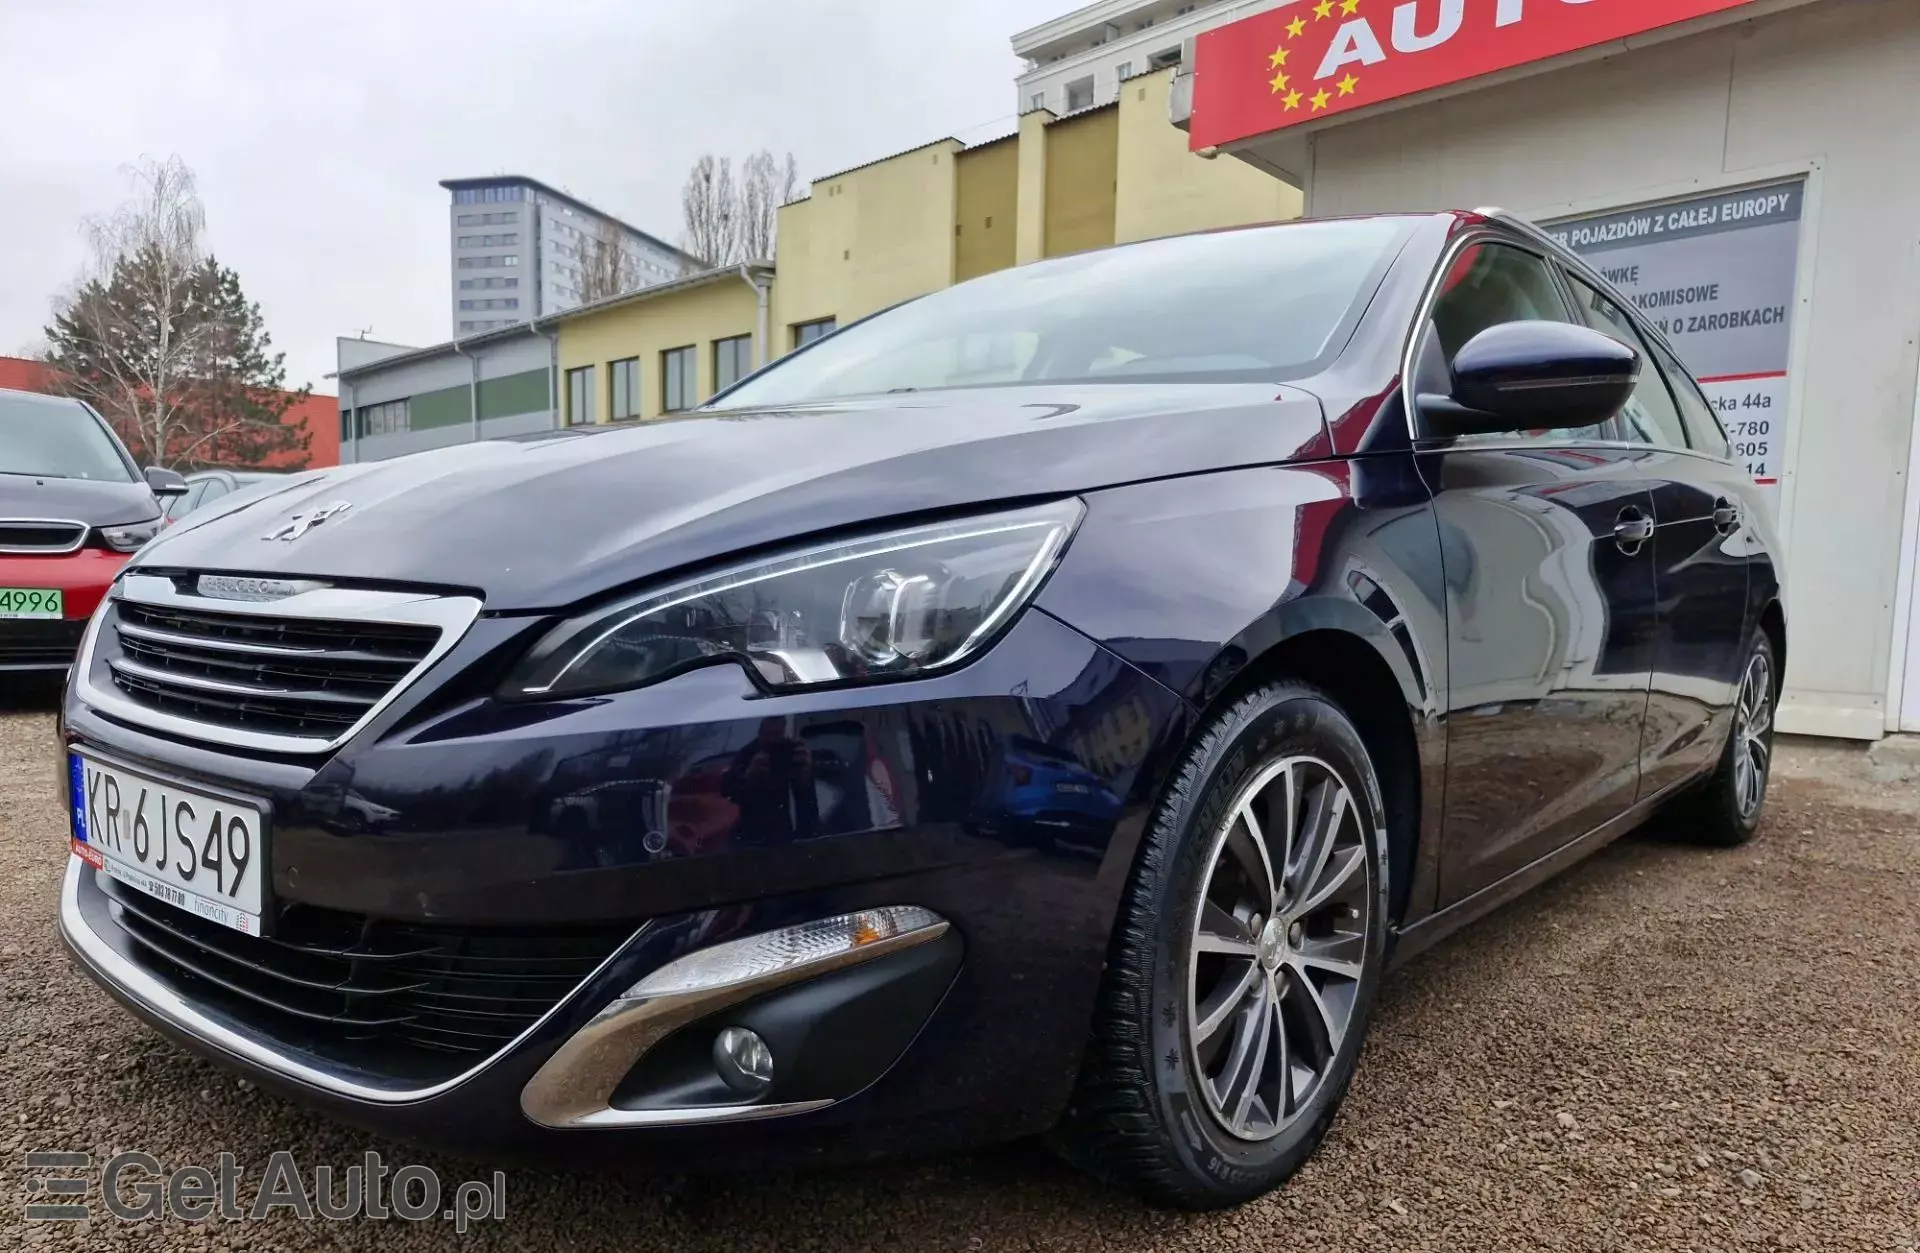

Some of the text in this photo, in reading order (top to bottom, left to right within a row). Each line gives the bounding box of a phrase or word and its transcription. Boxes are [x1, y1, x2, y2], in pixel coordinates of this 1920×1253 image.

[1313, 0, 1596, 80] AU
[1571, 216, 1651, 247] POJAZDÓW
[1653, 215, 1665, 233] Z
[1668, 208, 1718, 230] CAŁEJ
[1721, 193, 1791, 222] EUROPY
[1673, 318, 1684, 334] O
[1687, 306, 1785, 333] ZAROBKACH
[1742, 393, 1771, 409] 44a
[1725, 421, 1770, 436] -780
[0, 591, 58, 612] 4996
[87, 767, 251, 898] KR 6JS49
